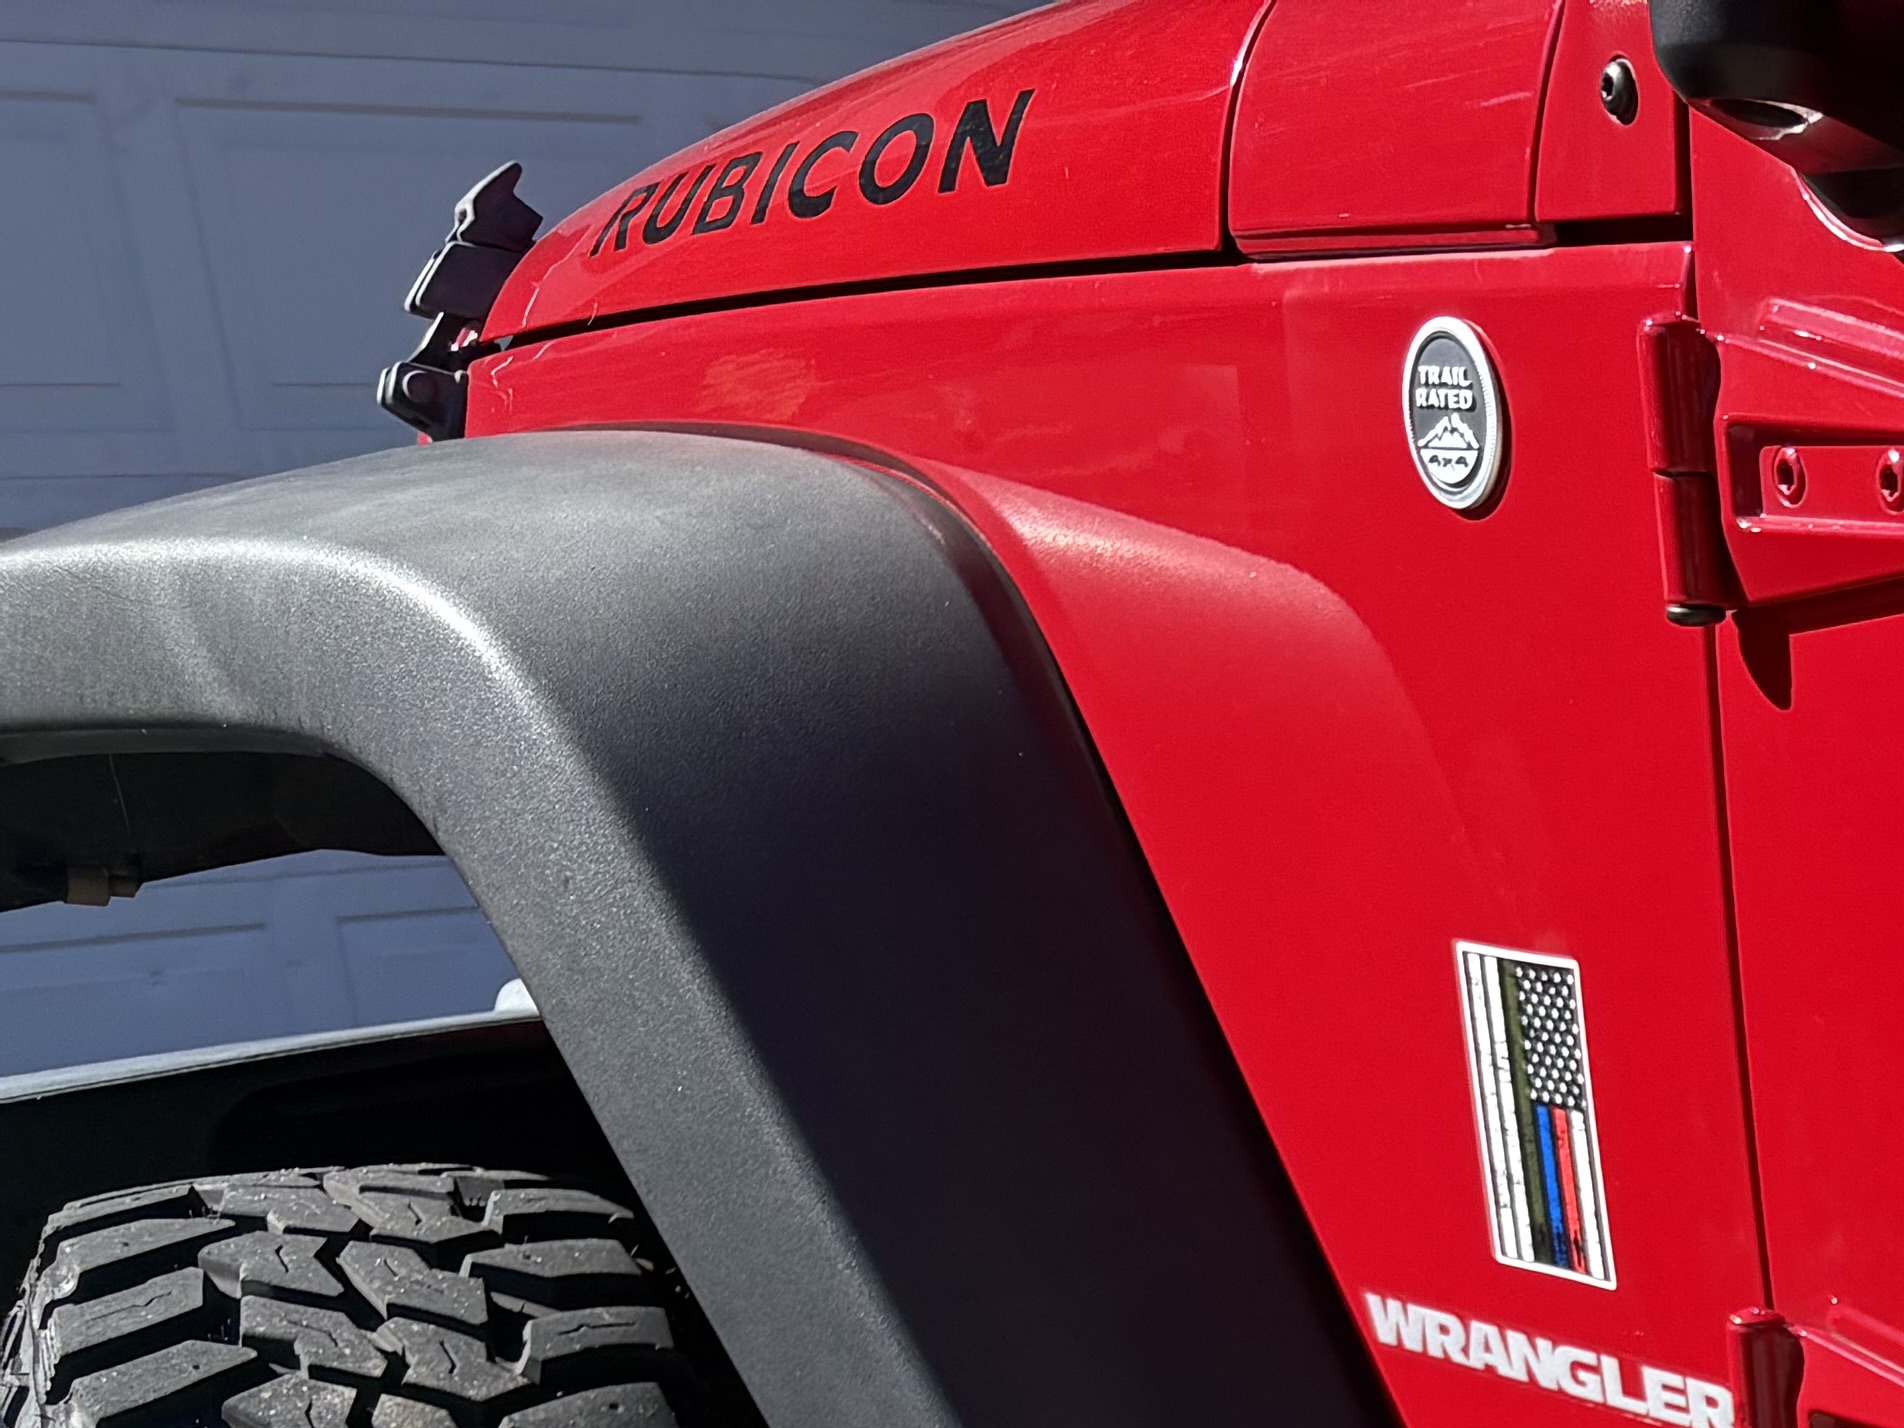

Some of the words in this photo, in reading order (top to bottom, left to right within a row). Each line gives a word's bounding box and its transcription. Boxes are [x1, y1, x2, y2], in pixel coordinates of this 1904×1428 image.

[590, 89, 1035, 257] RUBICON
[1418, 365, 1472, 387] TRAIL
[1415, 388, 1473, 410] RATED
